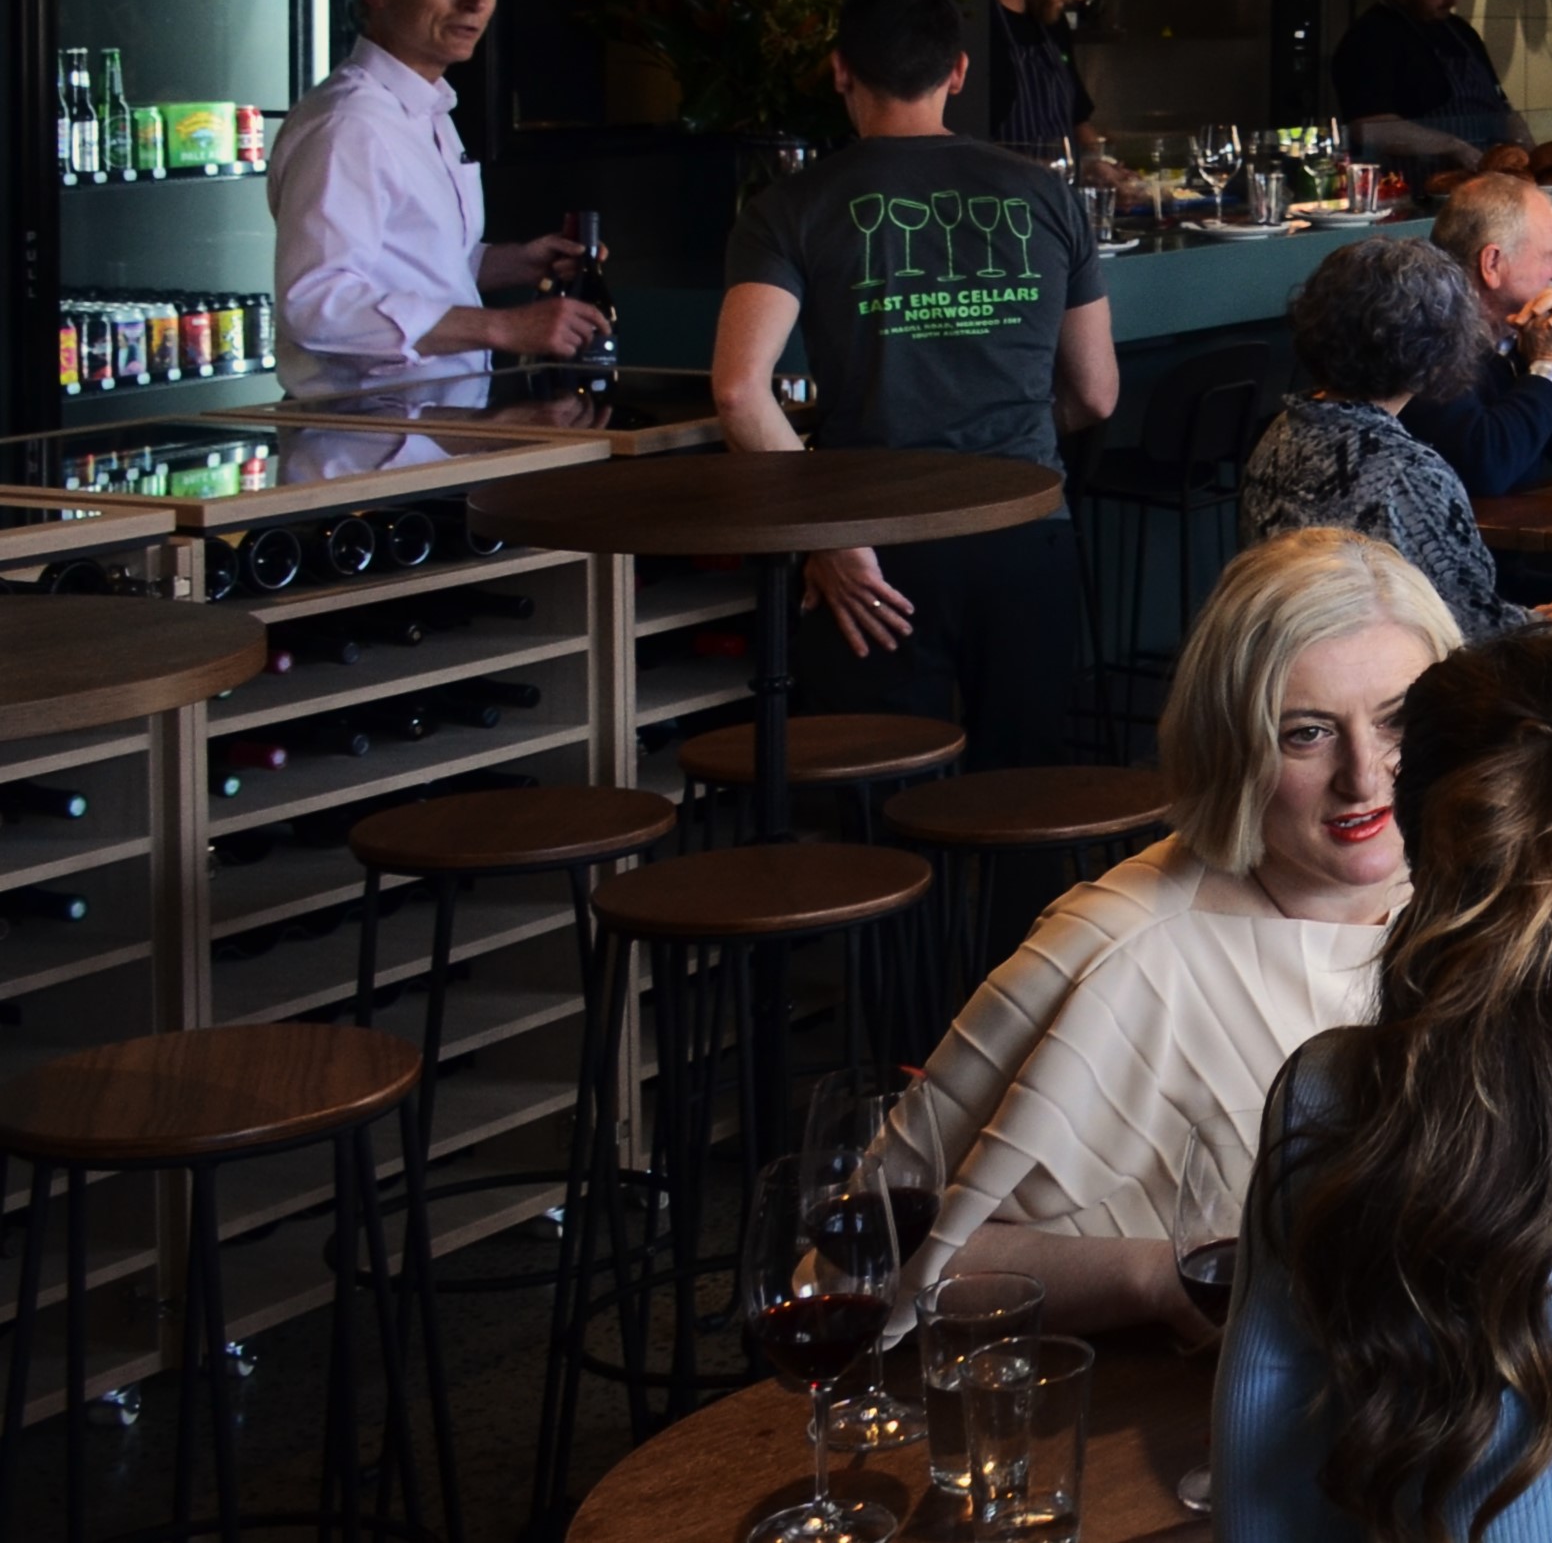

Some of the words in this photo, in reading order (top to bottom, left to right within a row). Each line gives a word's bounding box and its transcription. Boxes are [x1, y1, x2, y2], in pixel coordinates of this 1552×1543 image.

[858, 295, 903, 315] EAST
[909, 291, 951, 308] END
[957, 287, 1039, 304] CELLARS
[904, 305, 995, 322] NORWOOD
